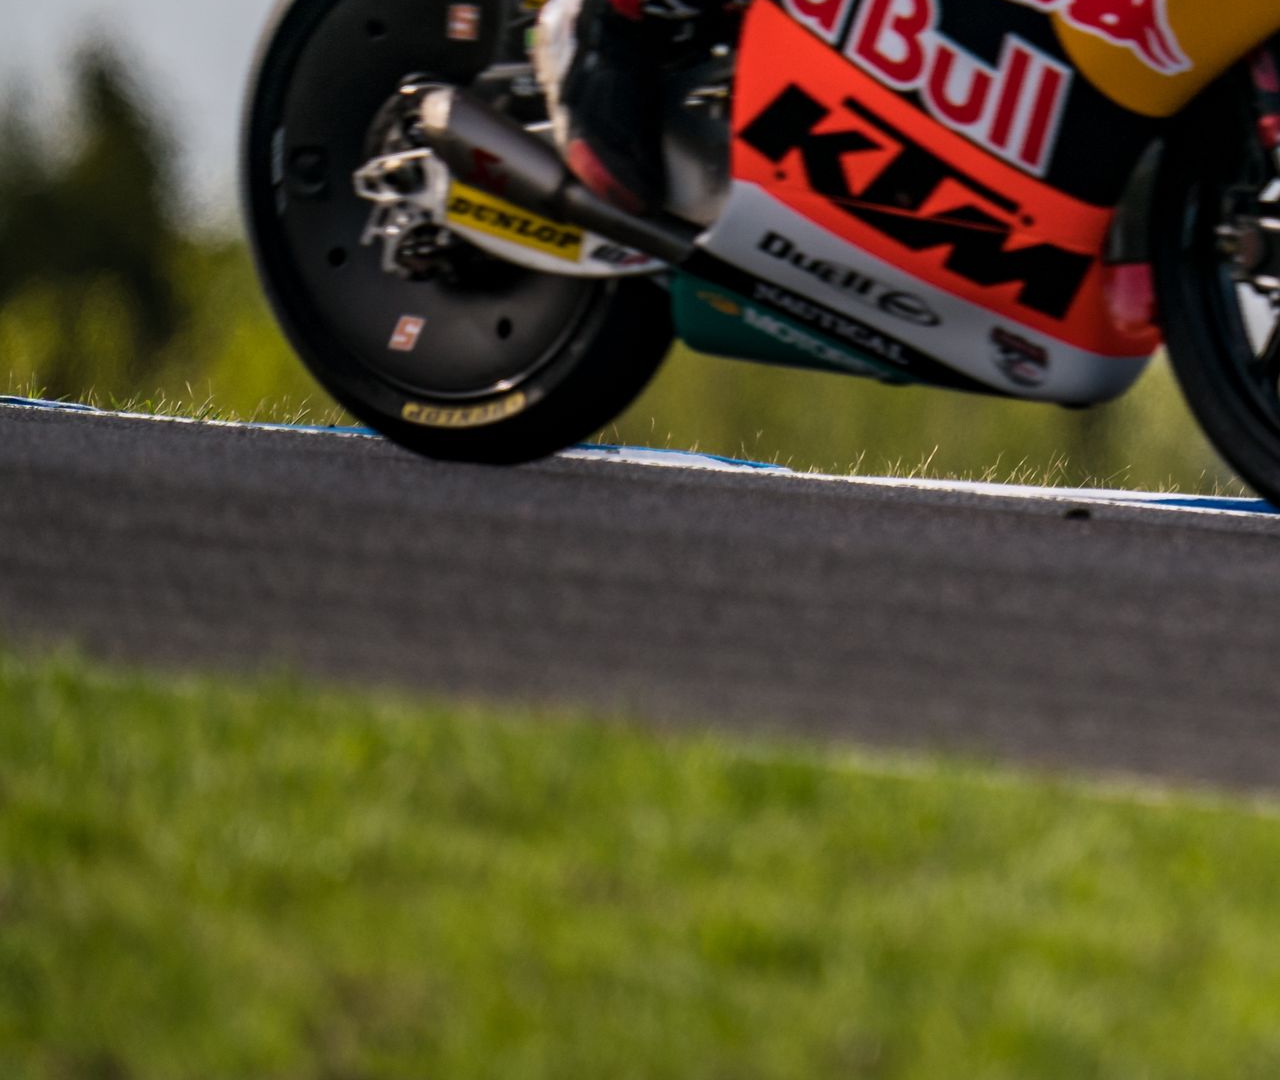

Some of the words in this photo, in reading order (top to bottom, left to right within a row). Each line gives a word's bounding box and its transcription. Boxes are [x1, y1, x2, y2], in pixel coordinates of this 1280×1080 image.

[449, 197, 582, 248] DUNLOP
[739, 82, 1096, 319] KTM
[757, 230, 873, 295] Duell
